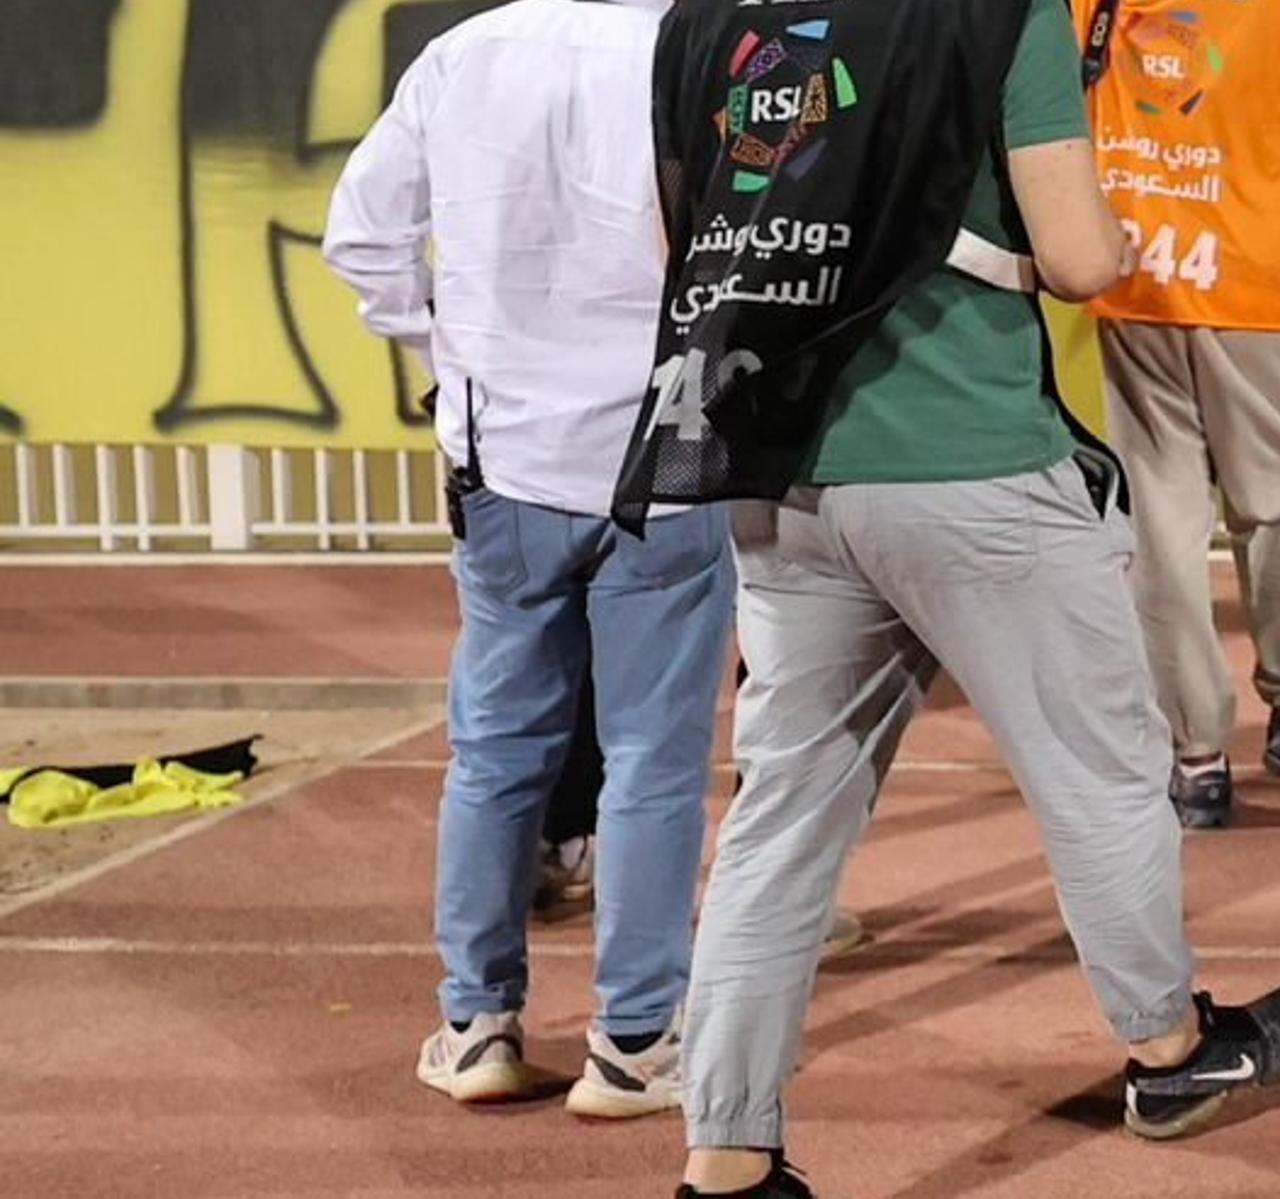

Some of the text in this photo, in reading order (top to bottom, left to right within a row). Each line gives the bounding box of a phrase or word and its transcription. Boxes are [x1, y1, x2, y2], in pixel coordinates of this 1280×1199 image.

[1141, 53, 1185, 80] RSL
[1162, 141, 1221, 173] دوري
[1100, 166, 1220, 203] السعودي
[749, 217, 851, 259] دوري
